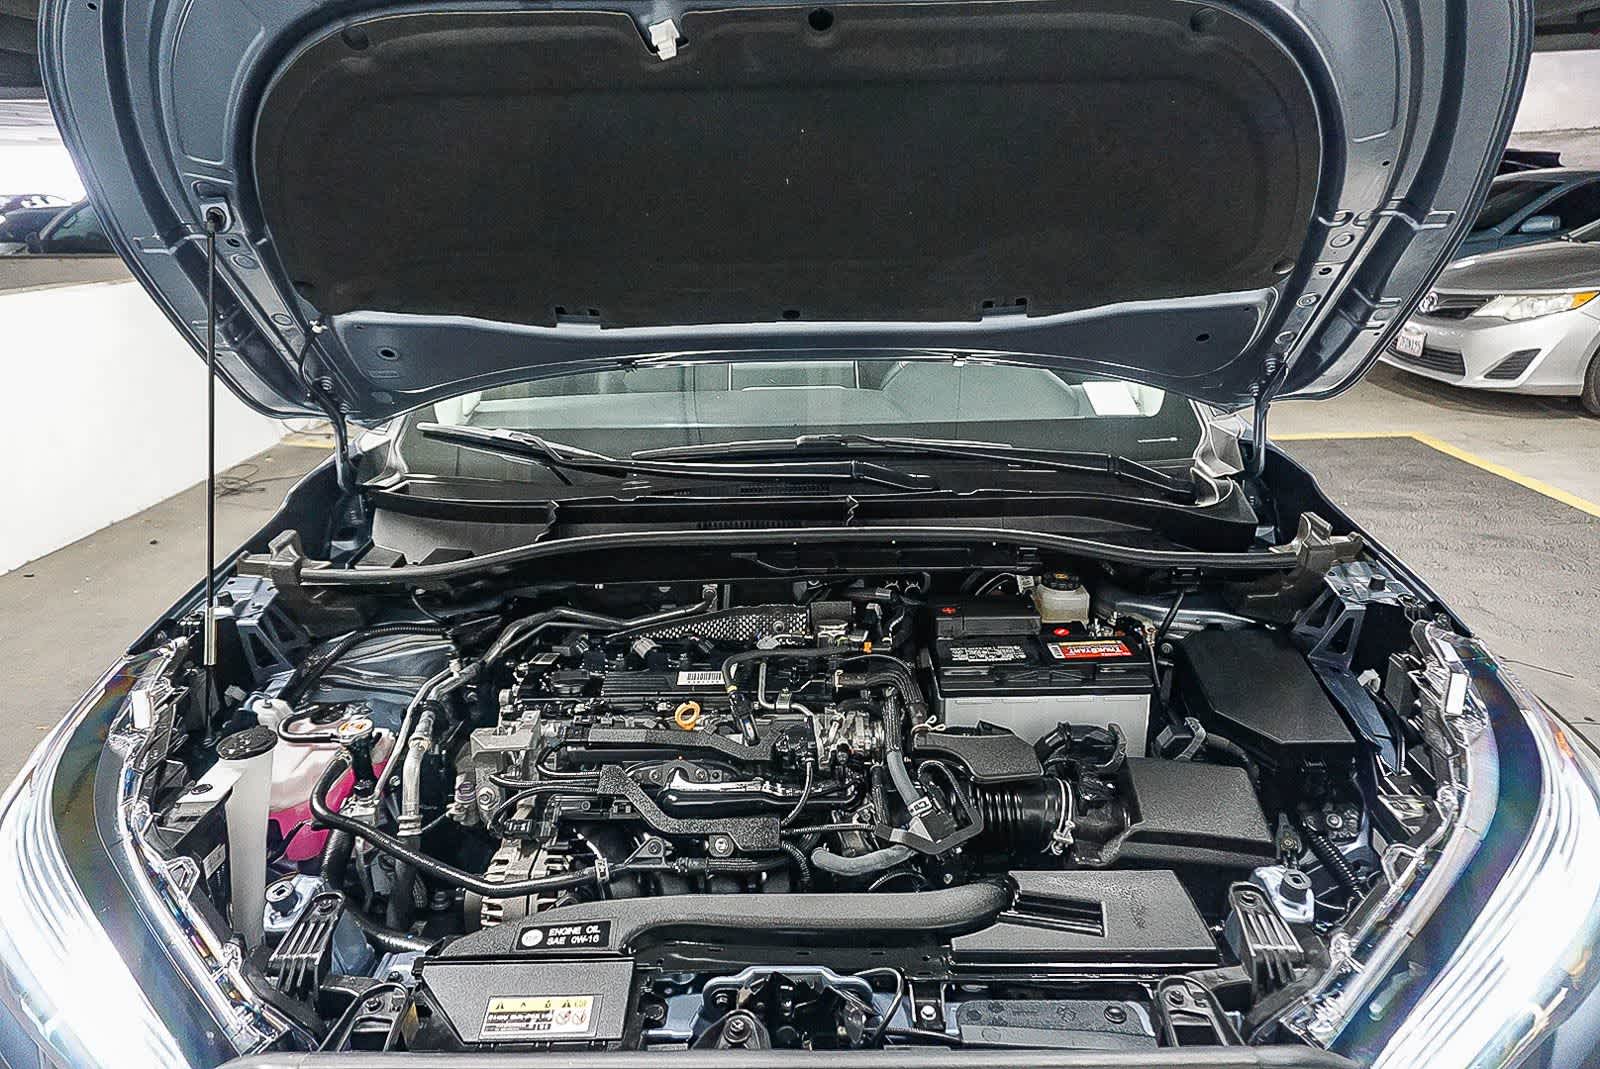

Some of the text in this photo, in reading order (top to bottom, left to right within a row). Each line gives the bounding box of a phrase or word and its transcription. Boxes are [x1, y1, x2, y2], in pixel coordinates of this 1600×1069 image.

[548, 925, 601, 936] ENGINE OIL
[546, 934, 600, 946] SAE 0W-16
